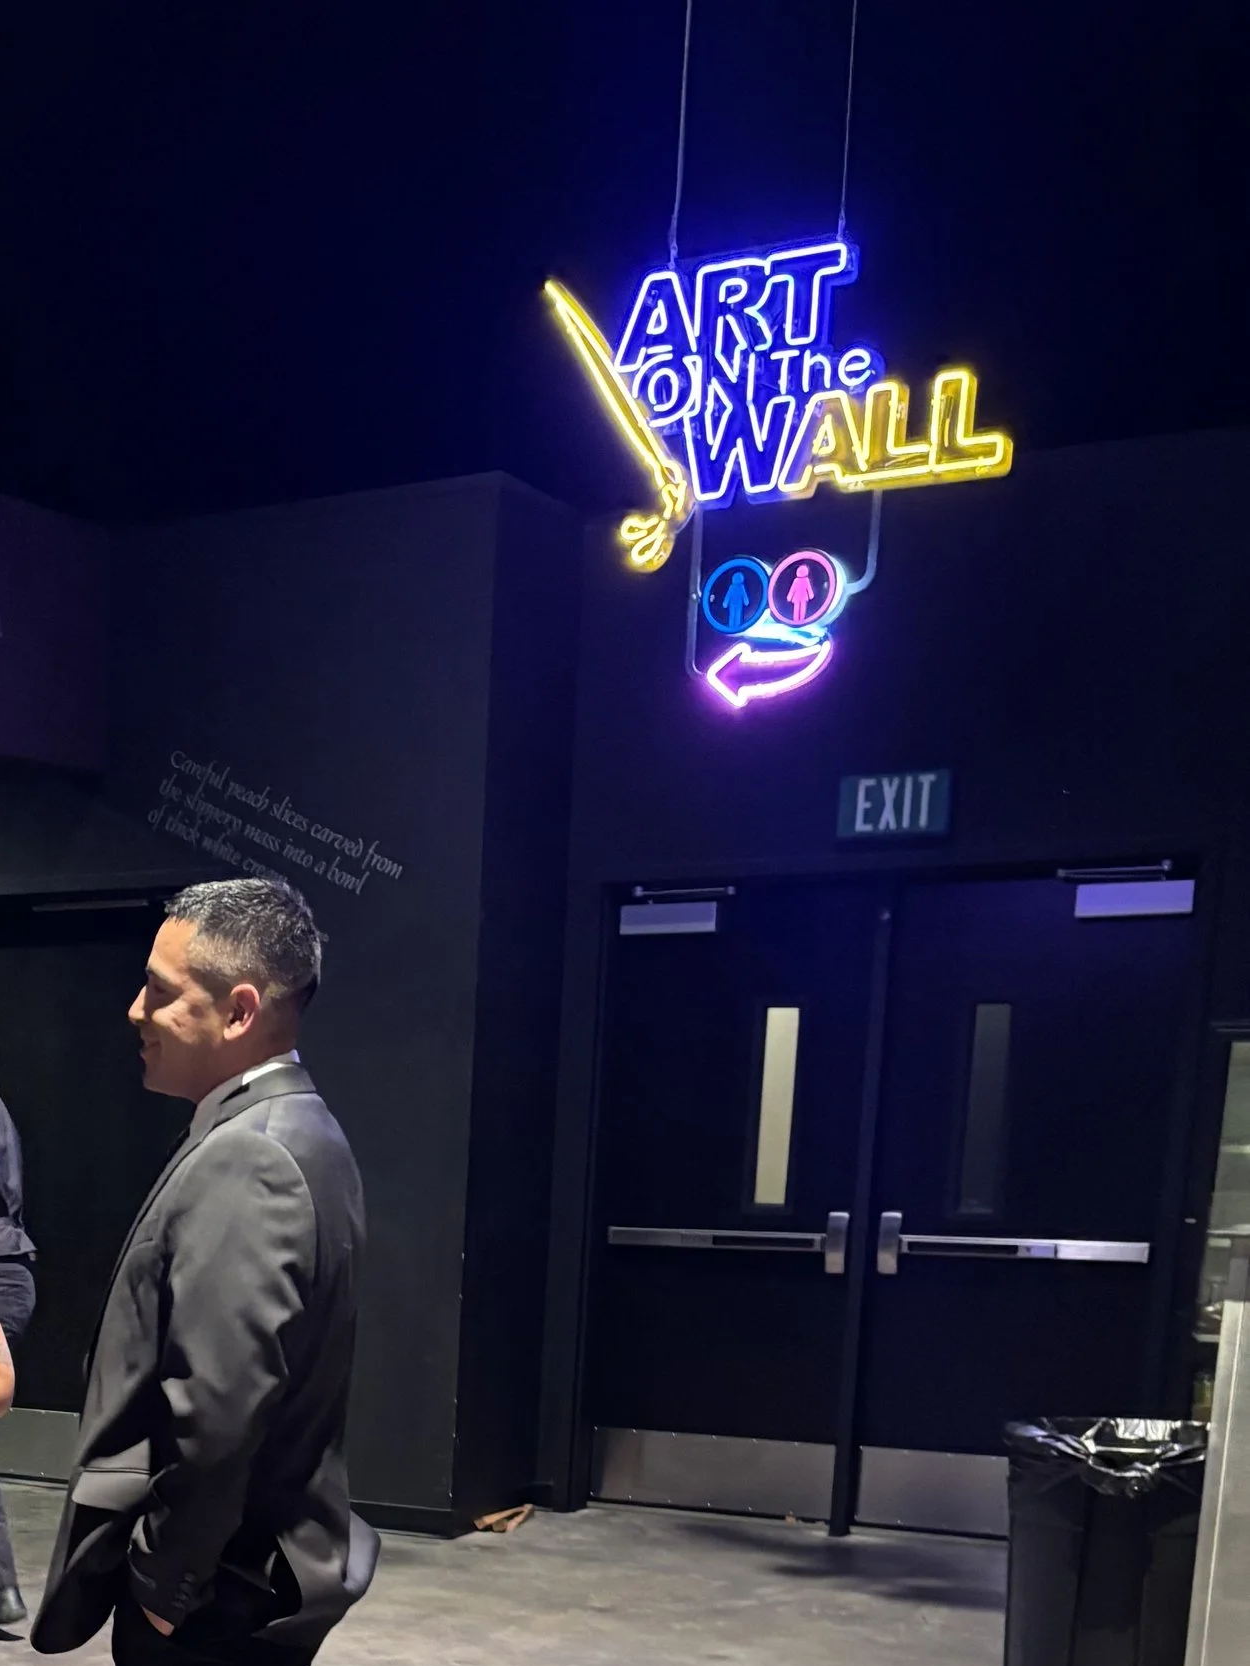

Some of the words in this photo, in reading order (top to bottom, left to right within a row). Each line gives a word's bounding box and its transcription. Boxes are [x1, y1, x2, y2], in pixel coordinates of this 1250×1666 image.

[613, 243, 849, 373] ART
[632, 338, 758, 428] ON
[772, 346, 873, 393] The
[685, 370, 1008, 500] WALL
[147, 804, 169, 831] of
[158, 773, 183, 802] the
[243, 823, 282, 852] mass
[282, 837, 314, 868] into
[313, 860, 327, 875] a
[326, 855, 370, 896] bowl
[170, 750, 231, 790] Careful
[224, 781, 271, 813] peach
[269, 795, 309, 832] slices
[310, 823, 364, 858] carved
[361, 840, 403, 880] from
[854, 773, 937, 832] EXIT
